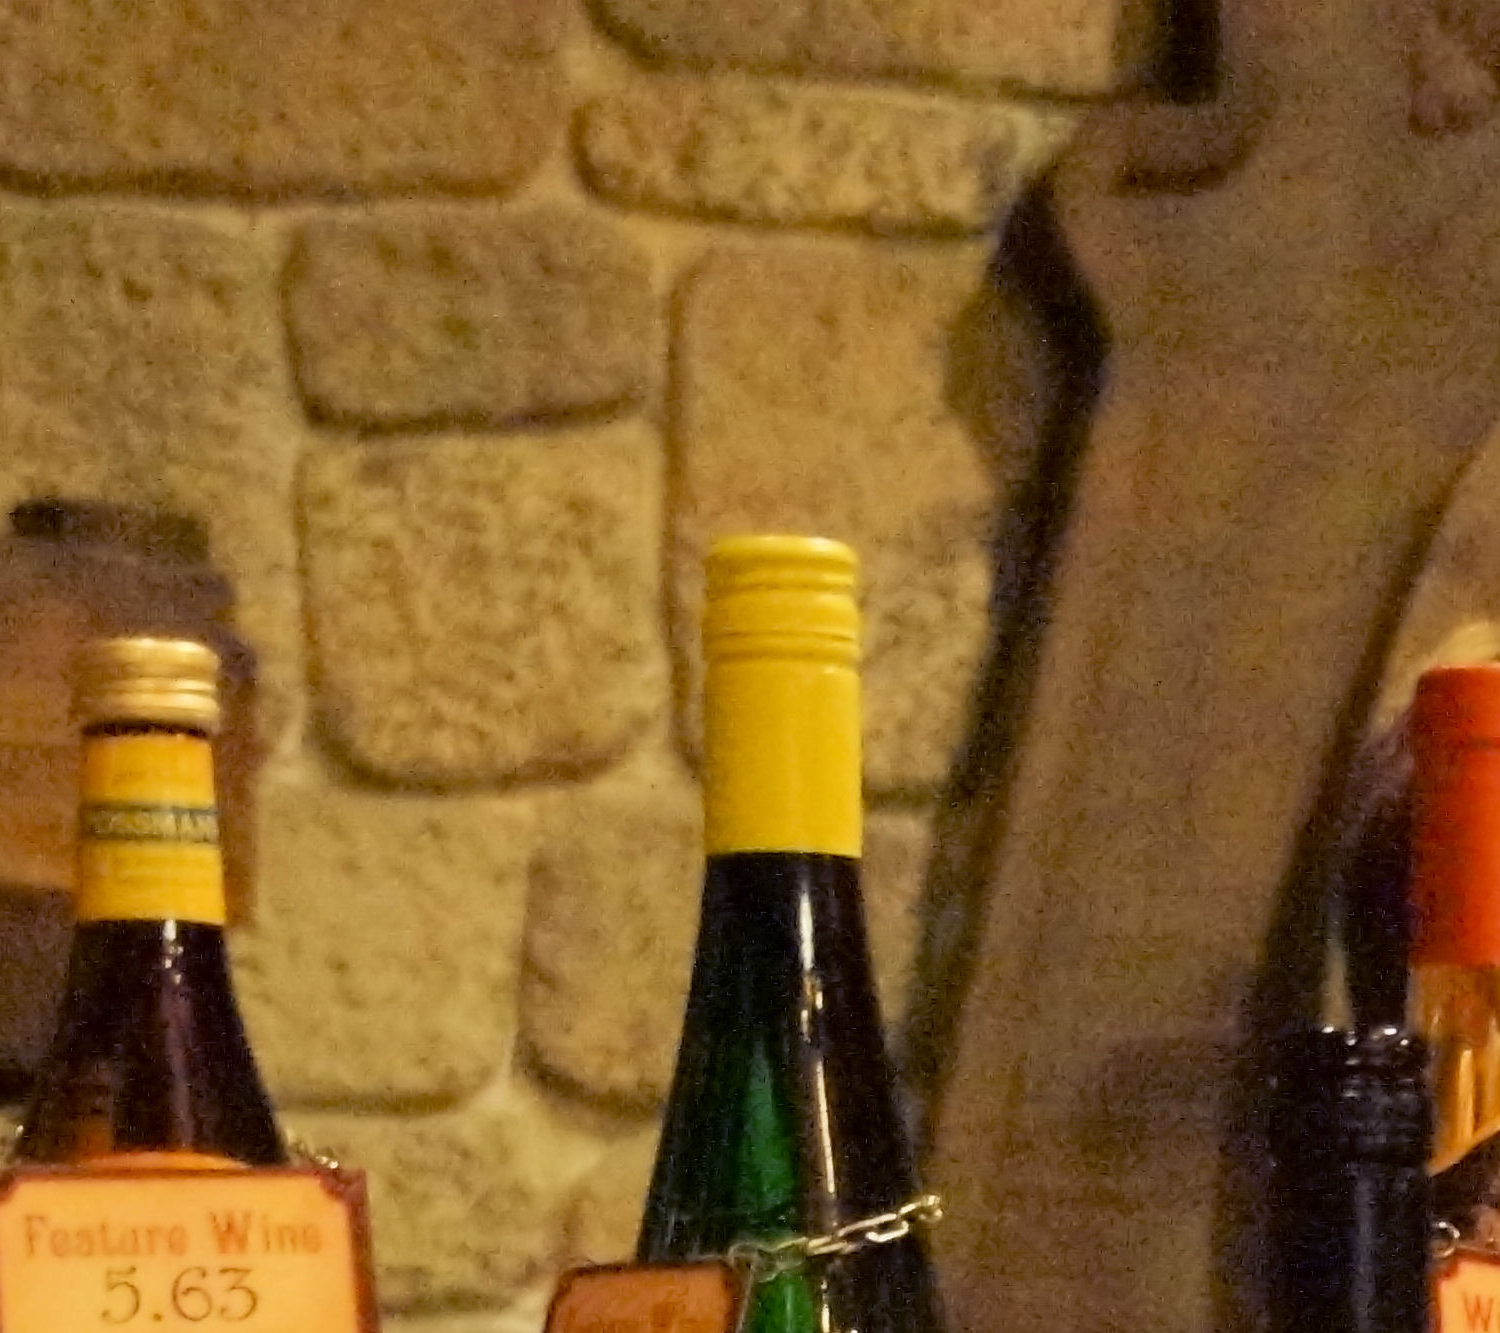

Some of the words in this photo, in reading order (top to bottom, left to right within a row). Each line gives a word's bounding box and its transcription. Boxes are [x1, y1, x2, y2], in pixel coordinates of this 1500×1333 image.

[23, 1213, 189, 1258] Feature
[211, 1210, 323, 1256] Wine
[100, 1264, 259, 1325] 5.63
